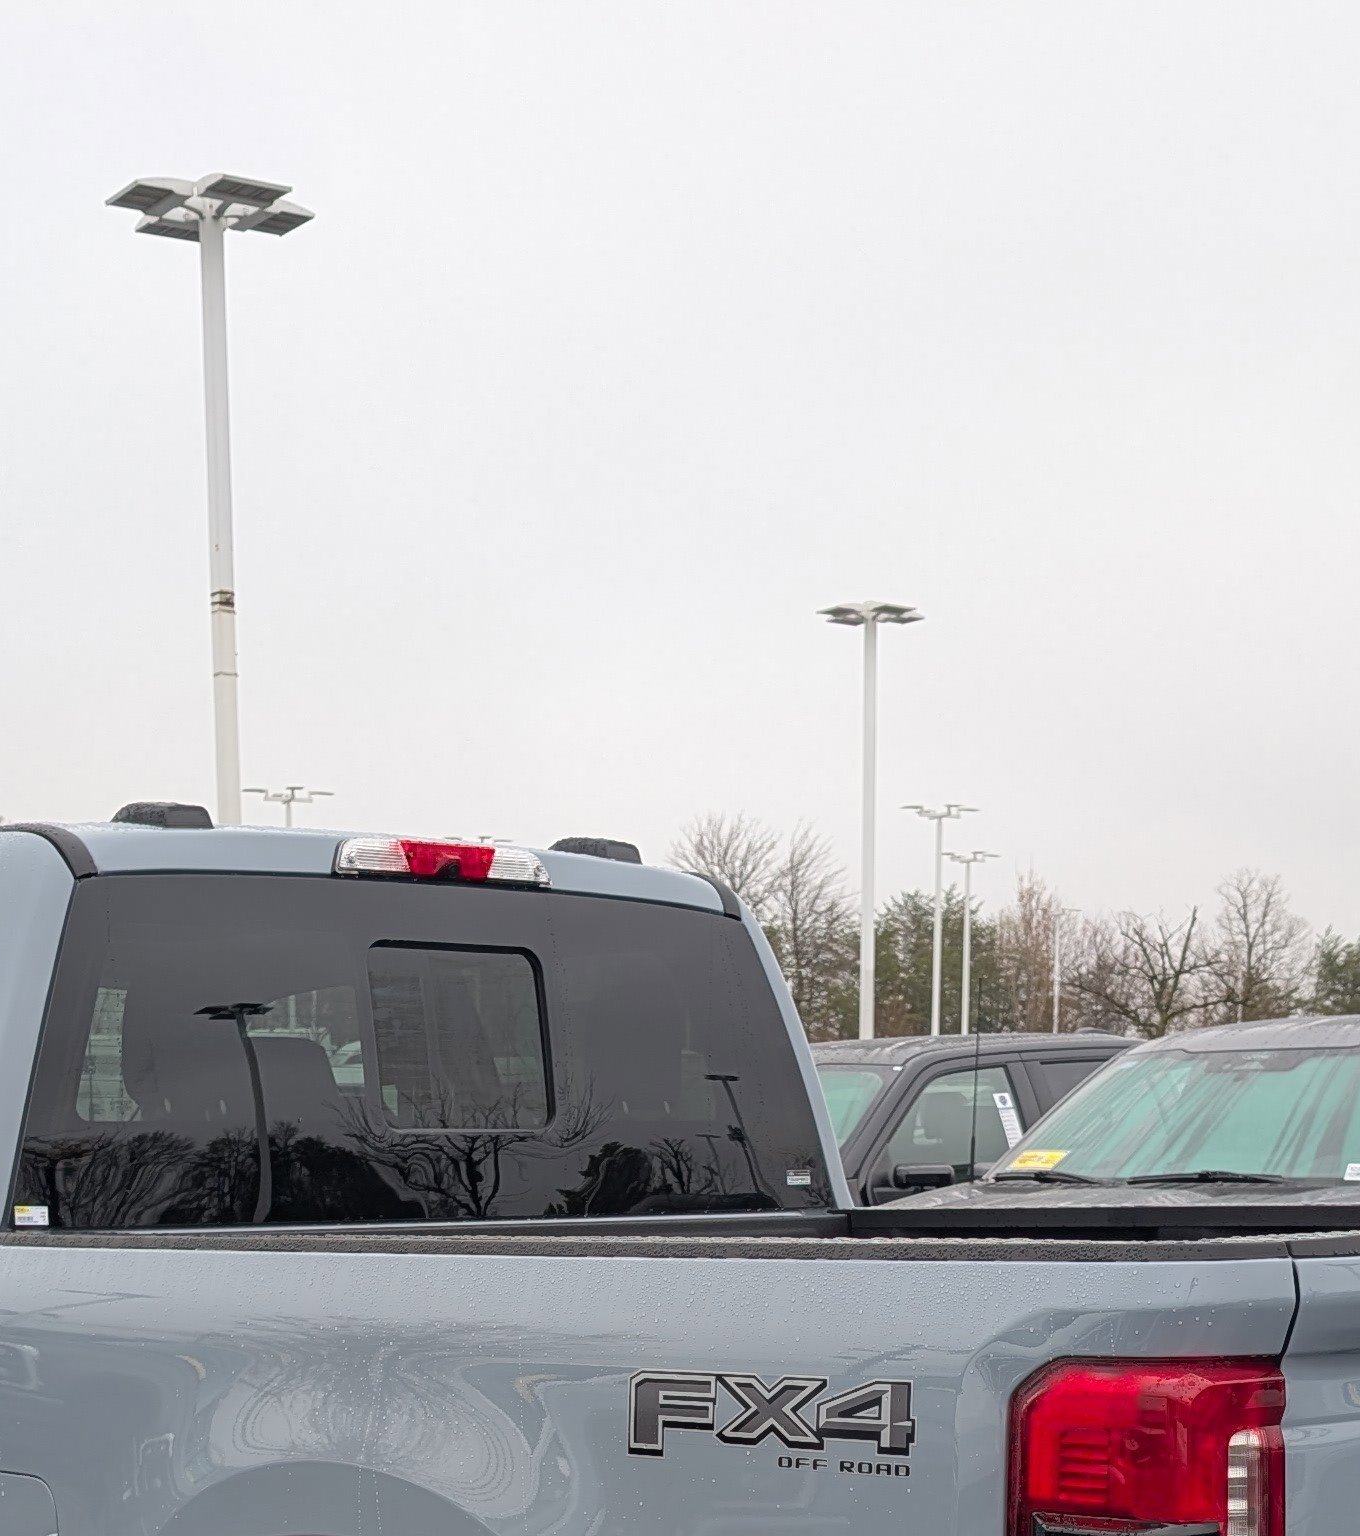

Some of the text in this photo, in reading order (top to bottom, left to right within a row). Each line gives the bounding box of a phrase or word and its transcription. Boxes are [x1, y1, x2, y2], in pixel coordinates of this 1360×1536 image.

[627, 1368, 918, 1458] FX4
[777, 1456, 911, 1477] OFF ROAD
